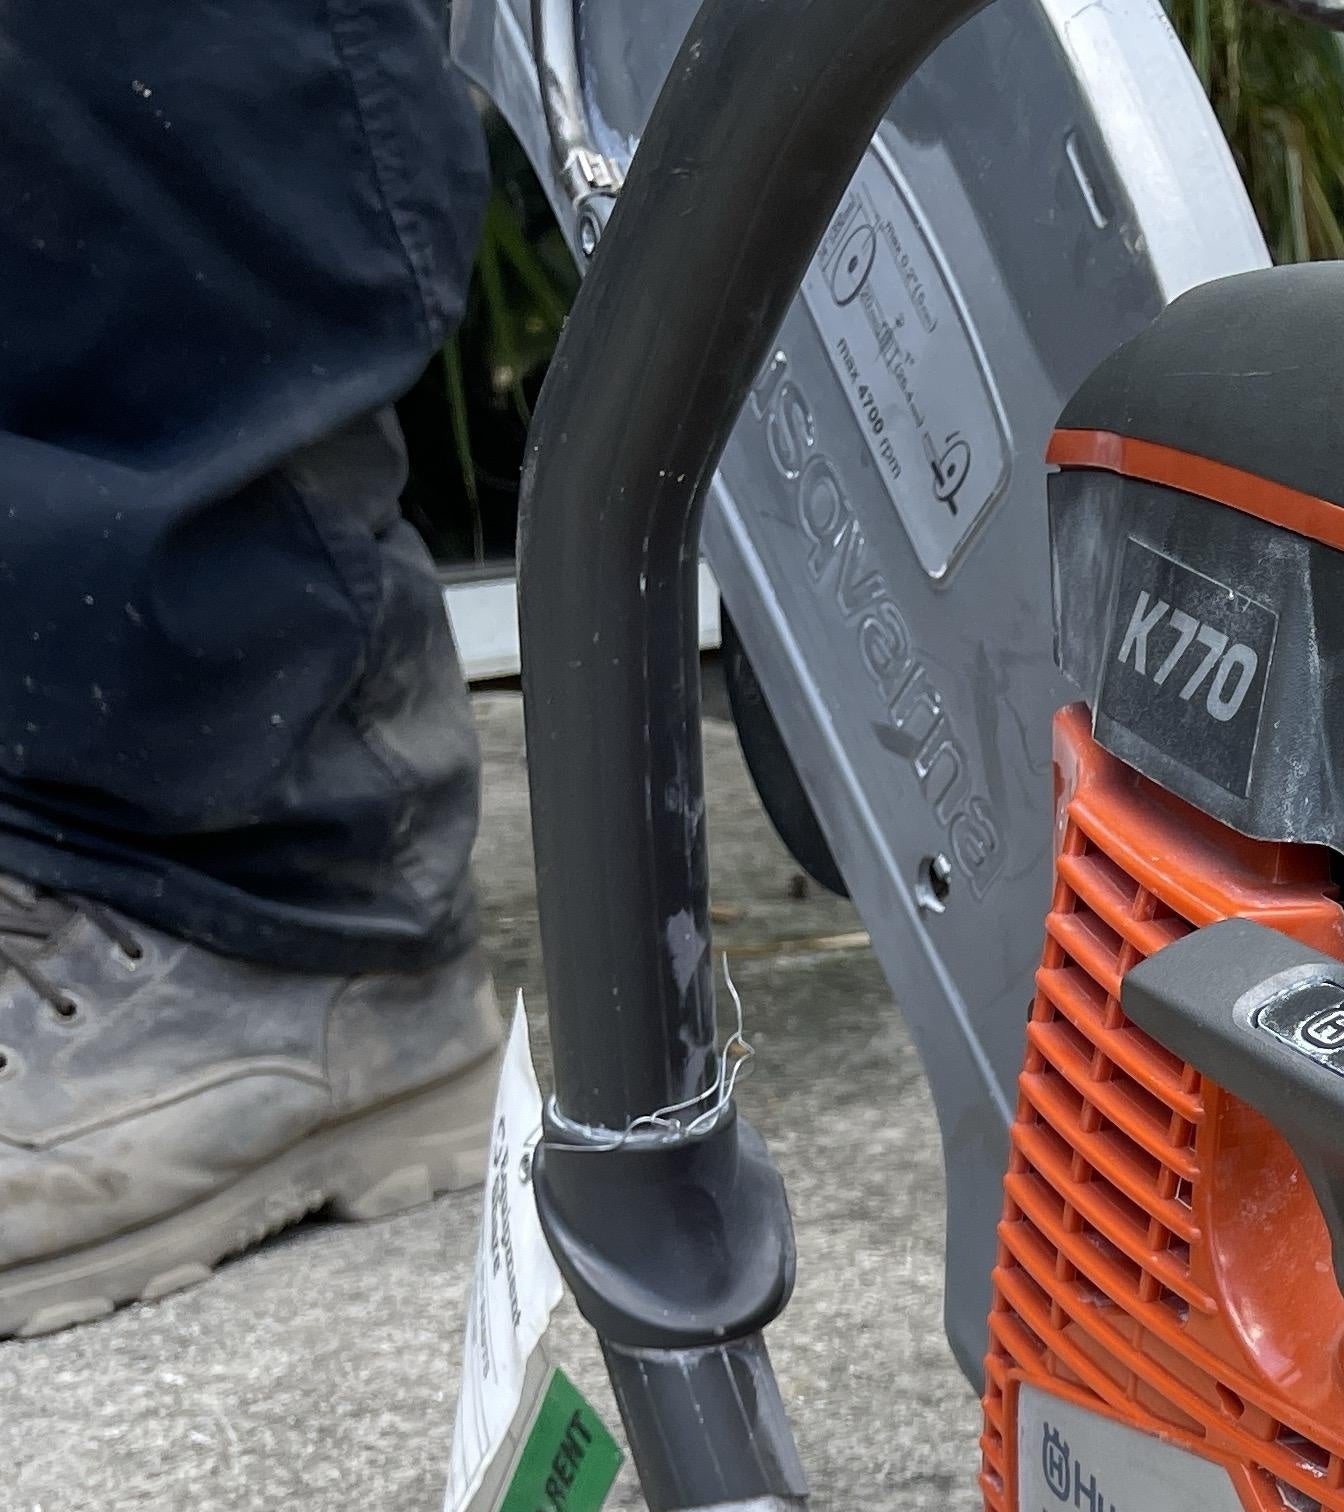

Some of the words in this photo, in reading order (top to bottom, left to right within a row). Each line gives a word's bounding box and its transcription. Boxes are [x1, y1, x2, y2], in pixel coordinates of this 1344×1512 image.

[836, 337, 861, 381] max
[857, 384, 885, 435] 4700
[879, 436, 902, 481] rpm
[1117, 590, 1259, 722] K770
